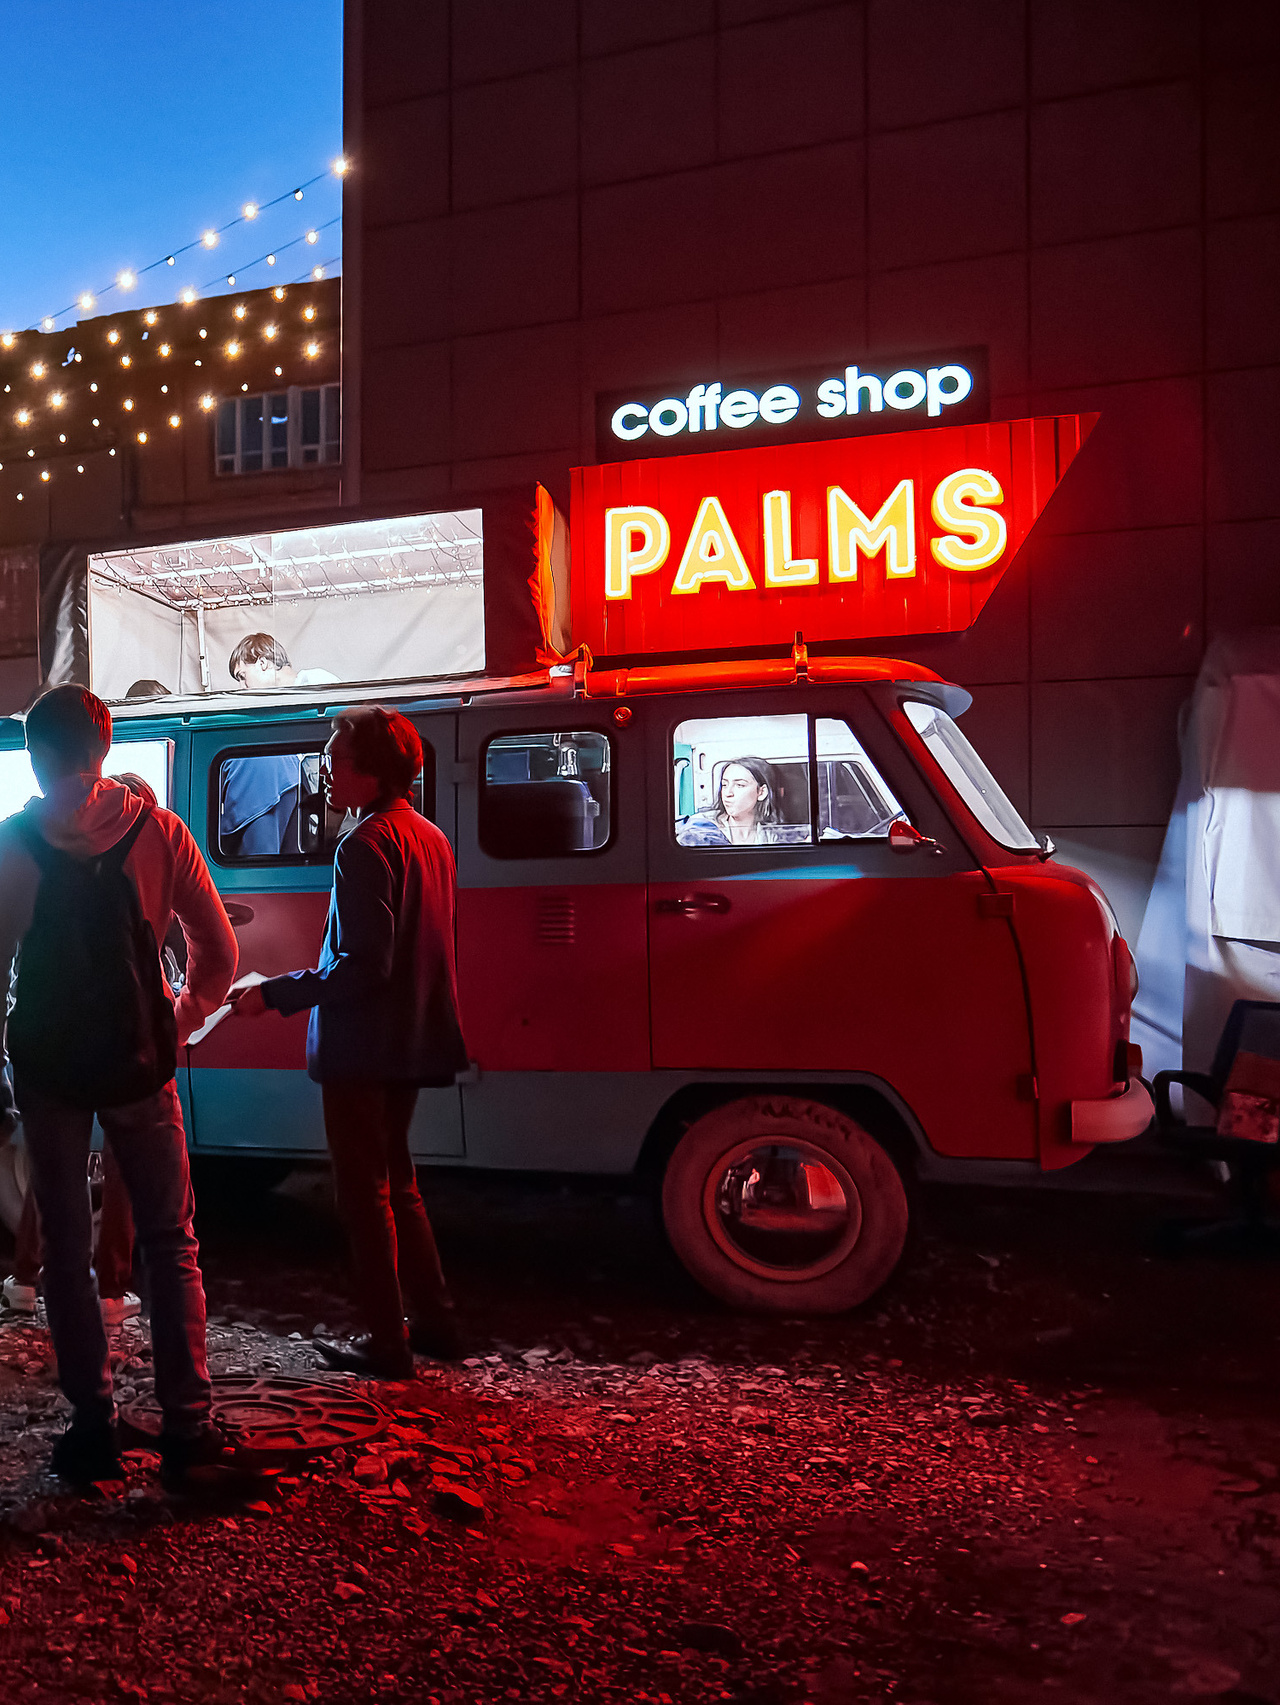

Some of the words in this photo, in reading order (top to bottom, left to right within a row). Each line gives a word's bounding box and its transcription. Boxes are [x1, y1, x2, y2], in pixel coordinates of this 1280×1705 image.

[611, 381, 801, 441] coffee
[816, 364, 972, 417] shop
[605, 468, 1007, 600] PALMS
